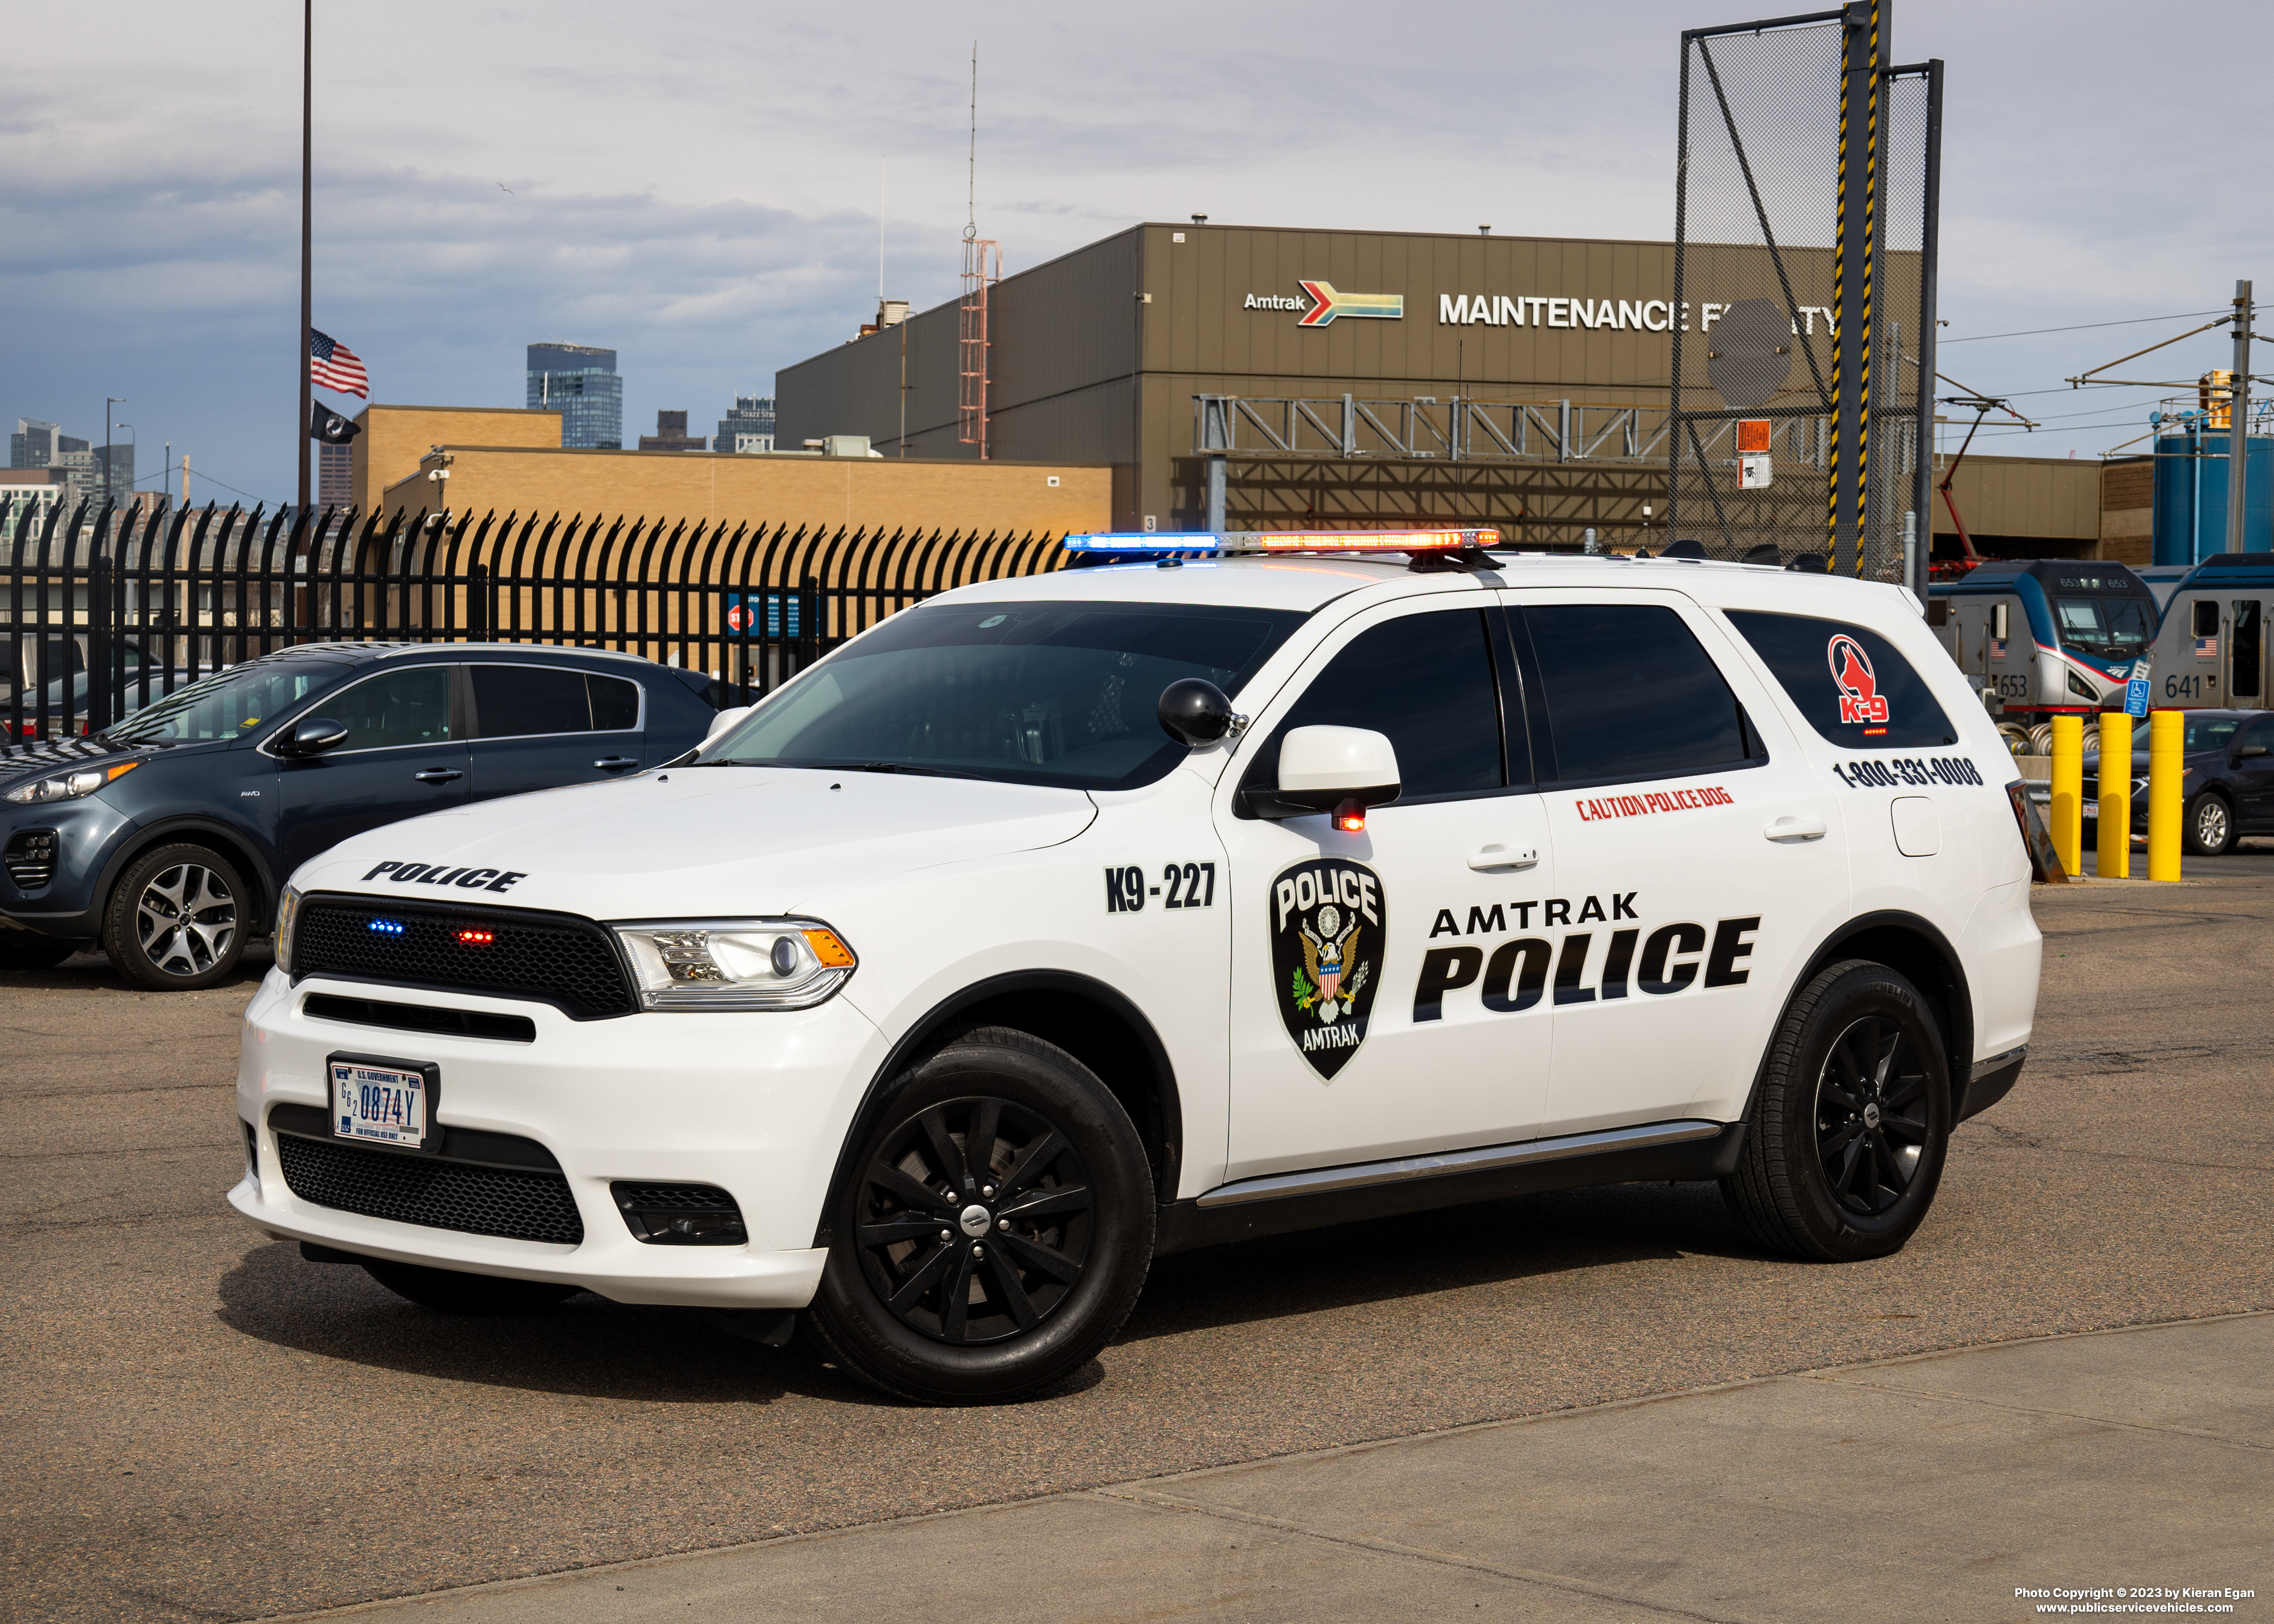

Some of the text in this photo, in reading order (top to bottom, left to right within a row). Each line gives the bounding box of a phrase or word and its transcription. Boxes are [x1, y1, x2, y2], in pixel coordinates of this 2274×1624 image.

[1244, 294, 1305, 310] Amtrak
[1440, 294, 1689, 331] MAINTENANCE
[1146, 519, 1154, 530] 3
[2060, 578, 2080, 587] 653
[2108, 579, 2128, 588] 653
[2001, 674, 2027, 697] 653
[2165, 674, 2199, 698] 641
[1839, 695, 1889, 723] K-9
[1832, 757, 1984, 788] 1-800-331-0008
[1576, 786, 1734, 821] CAUTION POLICE DOG
[360, 861, 529, 893] POLICE
[1276, 869, 1378, 933] POLICE
[181, 915, 190, 925] KIA
[1429, 891, 1639, 938] AMTRAK
[1339, 927, 1350, 940] UNUM
[1413, 915, 1761, 1023] POLICE
[1303, 1023, 1359, 1052] AMTRAK
[357, 1071, 398, 1084] U.S. GOVERNMENT
[361, 1085, 414, 1126] 0874Y
[363, 1129, 380, 1137] OFFICIAL
